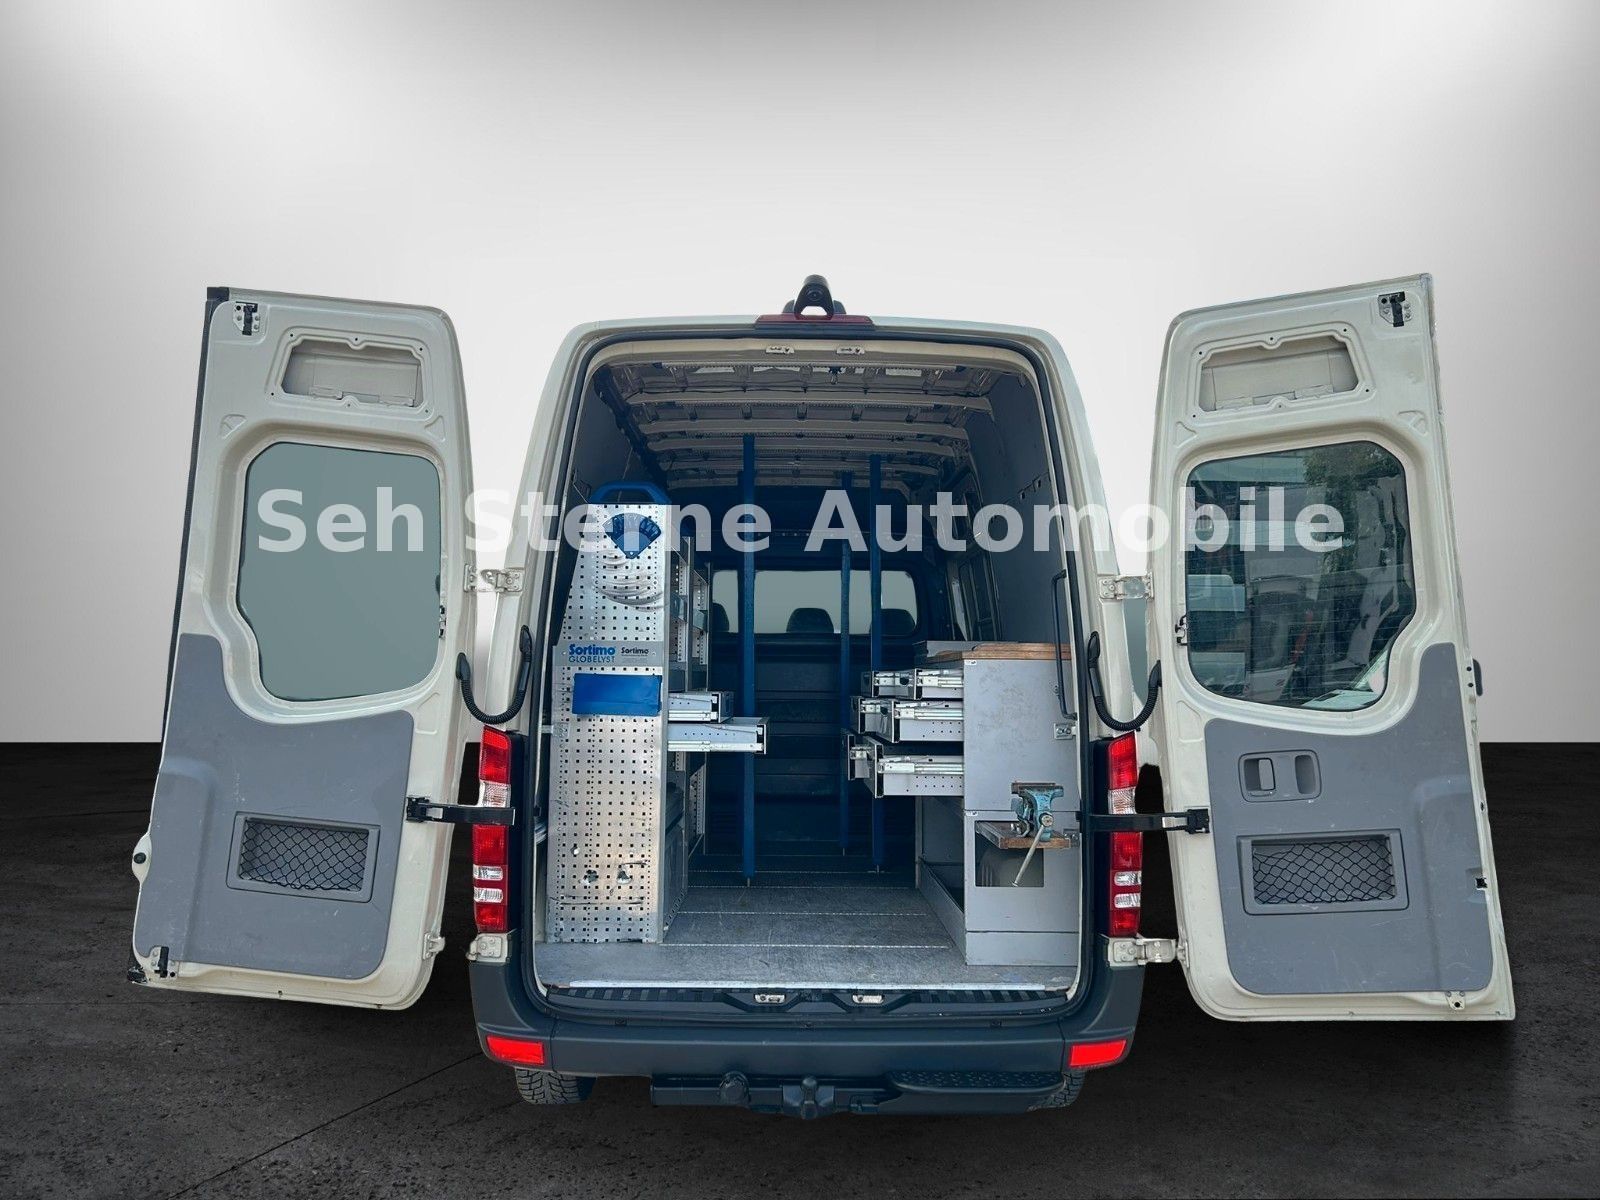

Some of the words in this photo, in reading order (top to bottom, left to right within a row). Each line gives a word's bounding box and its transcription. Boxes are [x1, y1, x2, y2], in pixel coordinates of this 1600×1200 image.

[568, 643, 616, 655] Sortimo
[620, 646, 649, 654] Sortimo
[568, 655, 615, 663] GLOBELYST
